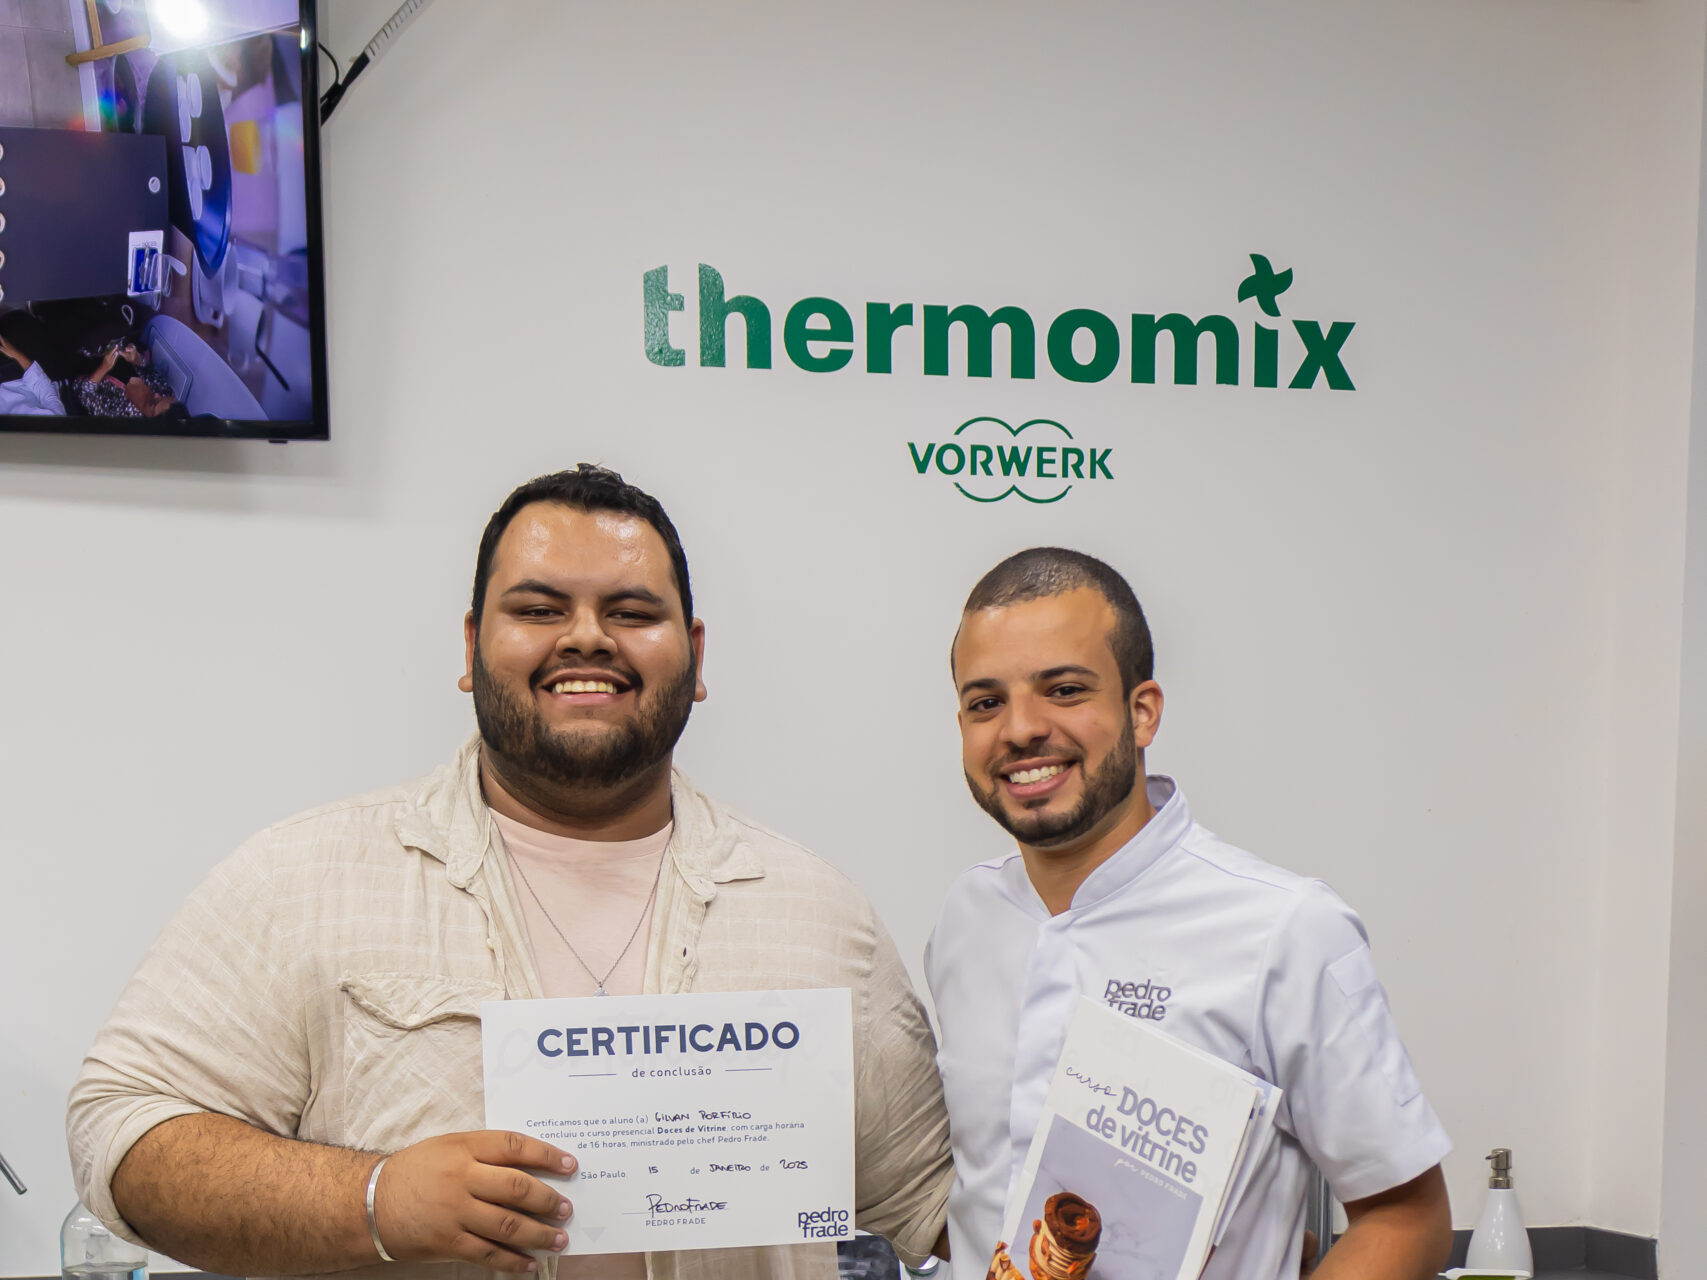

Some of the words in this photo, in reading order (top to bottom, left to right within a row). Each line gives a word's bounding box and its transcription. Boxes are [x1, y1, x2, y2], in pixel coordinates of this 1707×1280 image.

[642, 253, 1357, 392] thermomix
[907, 441, 1115, 480] VORWERK
[1104, 979, 1172, 1002] pedro
[537, 1021, 800, 1058] CERTIFICADO
[631, 1068, 647, 1078] de
[649, 1065, 712, 1078] conclusão
[1066, 1066, 1118, 1096] curso
[1117, 1086, 1209, 1154] DOCES
[526, 1118, 582, 1128] Certificamos
[583, 1118, 601, 1128] que
[609, 1117, 634, 1125] aluno
[539, 1130, 577, 1139] concluiu
[612, 1128, 655, 1139] presencial
[657, 1126, 683, 1135] Doces
[750, 1123, 773, 1132] carga
[577, 1141, 588, 1149] de
[630, 1138, 675, 1148] ministrado
[677, 1138, 695, 1147] pelo
[697, 1136, 715, 1145] chef
[718, 1135, 742, 1144] Pedro
[1086, 1104, 1117, 1139] de
[1121, 1123, 1198, 1183] vitrine
[580, 1171, 598, 1179] São
[648, 1166, 659, 1174] 15
[690, 1167, 701, 1175] de
[760, 1163, 770, 1172] de
[645, 1218, 675, 1227] PEDRO
[676, 1217, 706, 1225] FRADE
[797, 1206, 850, 1227] pedro
[801, 1221, 849, 1238] frade
